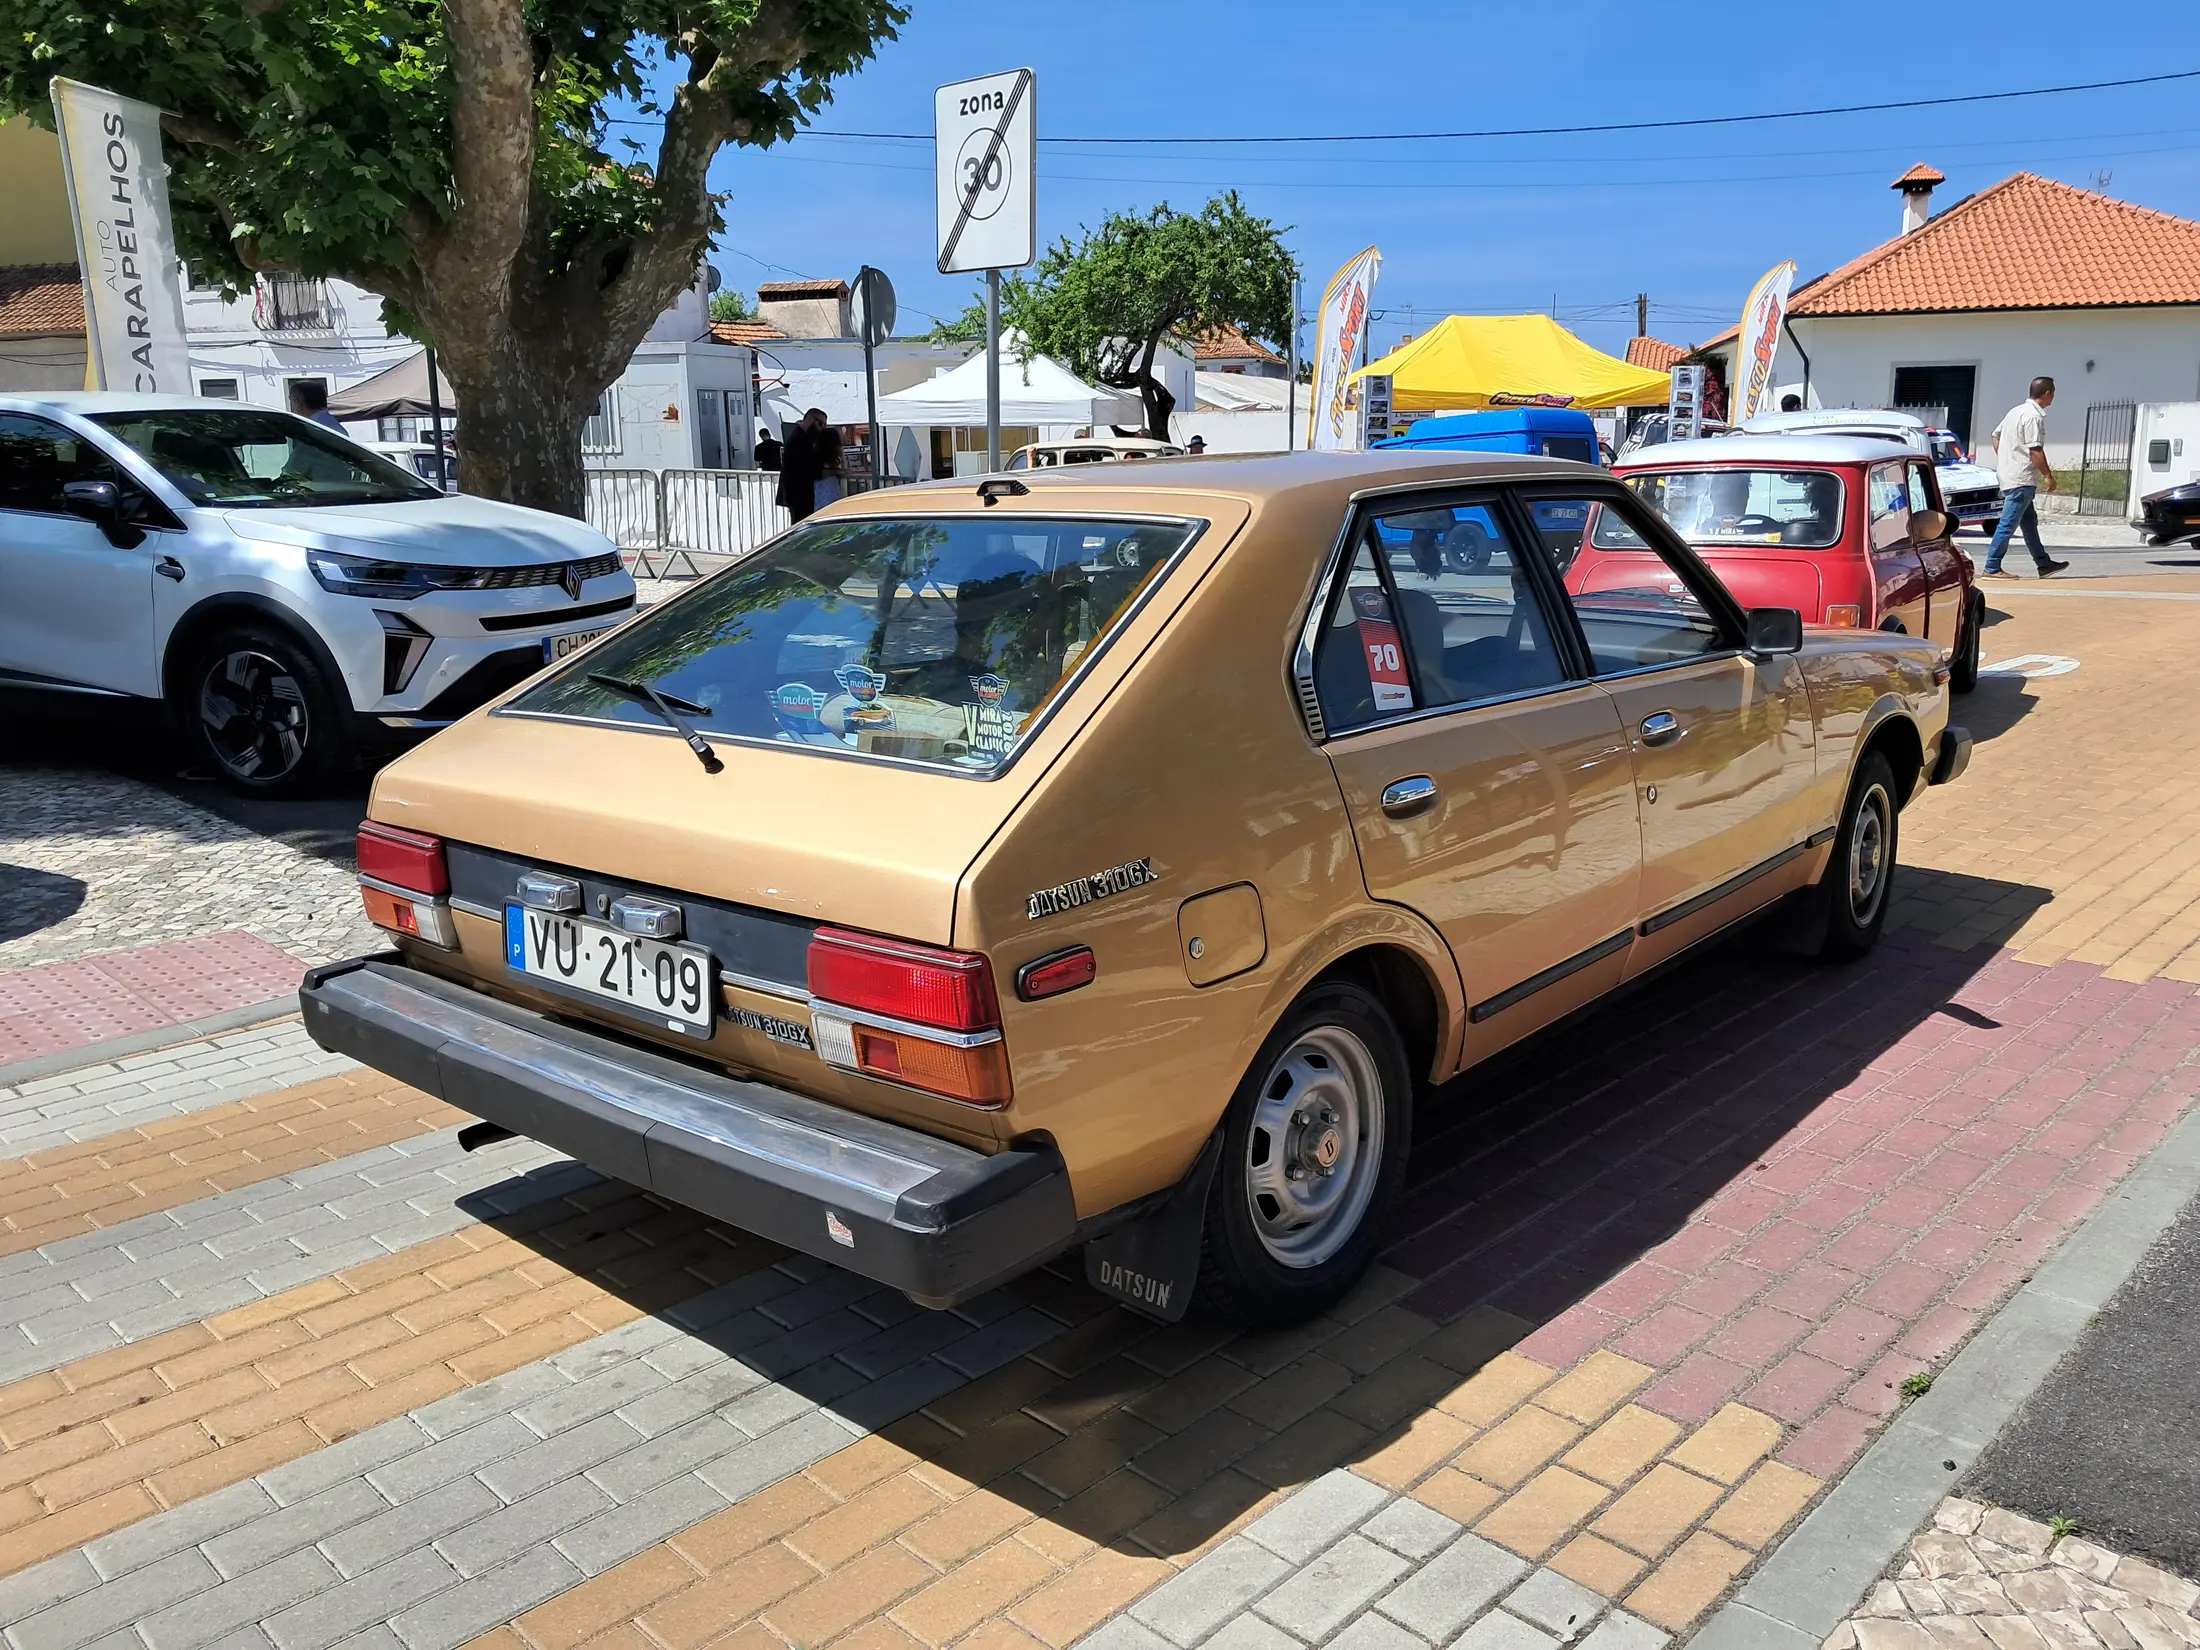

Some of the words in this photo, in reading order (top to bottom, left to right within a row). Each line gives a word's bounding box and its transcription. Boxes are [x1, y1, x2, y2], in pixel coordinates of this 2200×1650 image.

[959, 91, 1004, 116] zona
[963, 153, 1003, 194] 30
[97, 220, 118, 292] AUTO
[1369, 643, 1400, 671] 70
[850, 679, 873, 689] motor
[980, 685, 998, 693] motor
[783, 694, 812, 705] motor
[979, 707, 1002, 723] MIRA
[977, 722, 1003, 738] MOTOR
[1028, 878, 1093, 920] DATSUN
[1092, 858, 1159, 899] 310GX
[513, 943, 521, 957] P
[763, 1016, 809, 1044] 310GX
[1101, 1260, 1171, 1308] DATSUN
